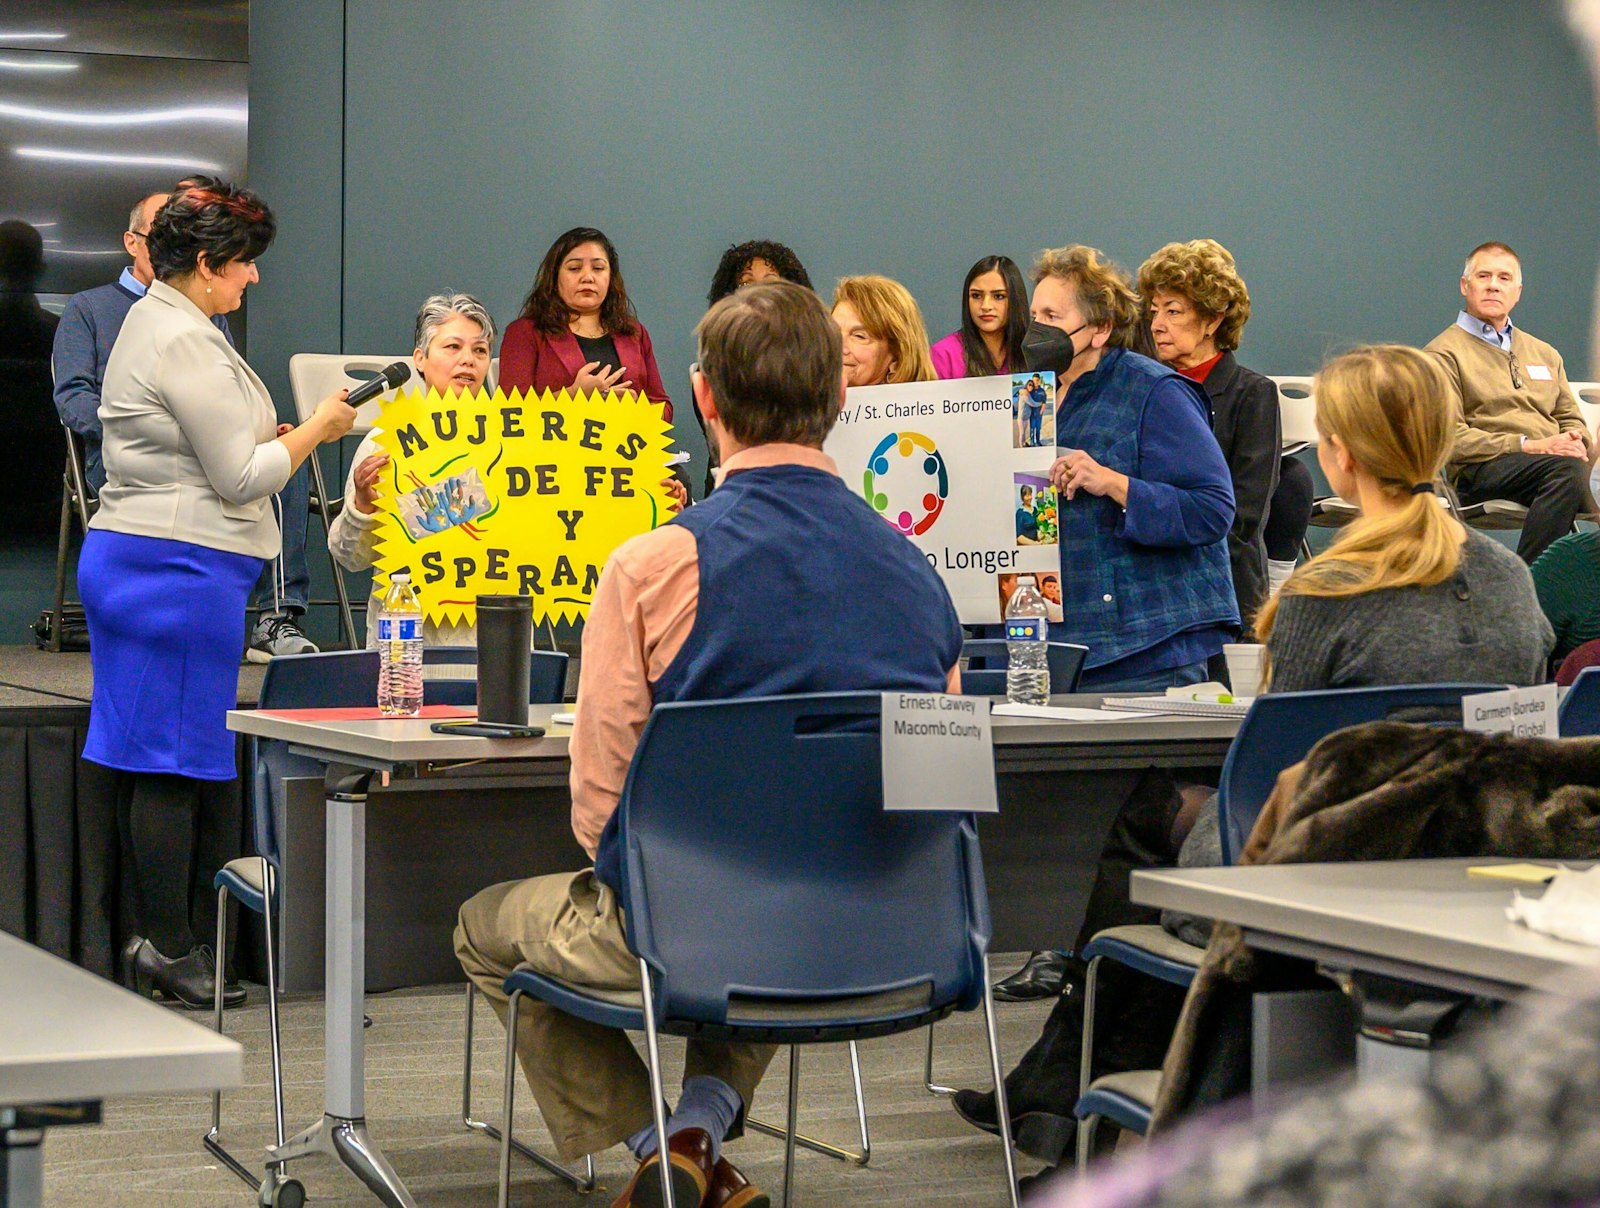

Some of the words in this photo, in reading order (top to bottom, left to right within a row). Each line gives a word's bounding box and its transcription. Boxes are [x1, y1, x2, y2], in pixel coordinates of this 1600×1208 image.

[835, 410, 851, 424] ty
[854, 404, 861, 423] /
[864, 405, 881, 420] St.
[886, 401, 934, 418] Charles
[943, 396, 1012, 414] Borromeo
[396, 407, 647, 461] MUJERES
[506, 464, 560, 497] DE
[585, 465, 635, 497] FE
[557, 510, 584, 540] Y
[945, 547, 1020, 574] Longer
[899, 694, 936, 710] Ernest
[939, 696, 976, 715] Cawvey
[1475, 706, 1511, 721] Carmen
[894, 720, 947, 736] Macomb
[949, 721, 982, 741] County
